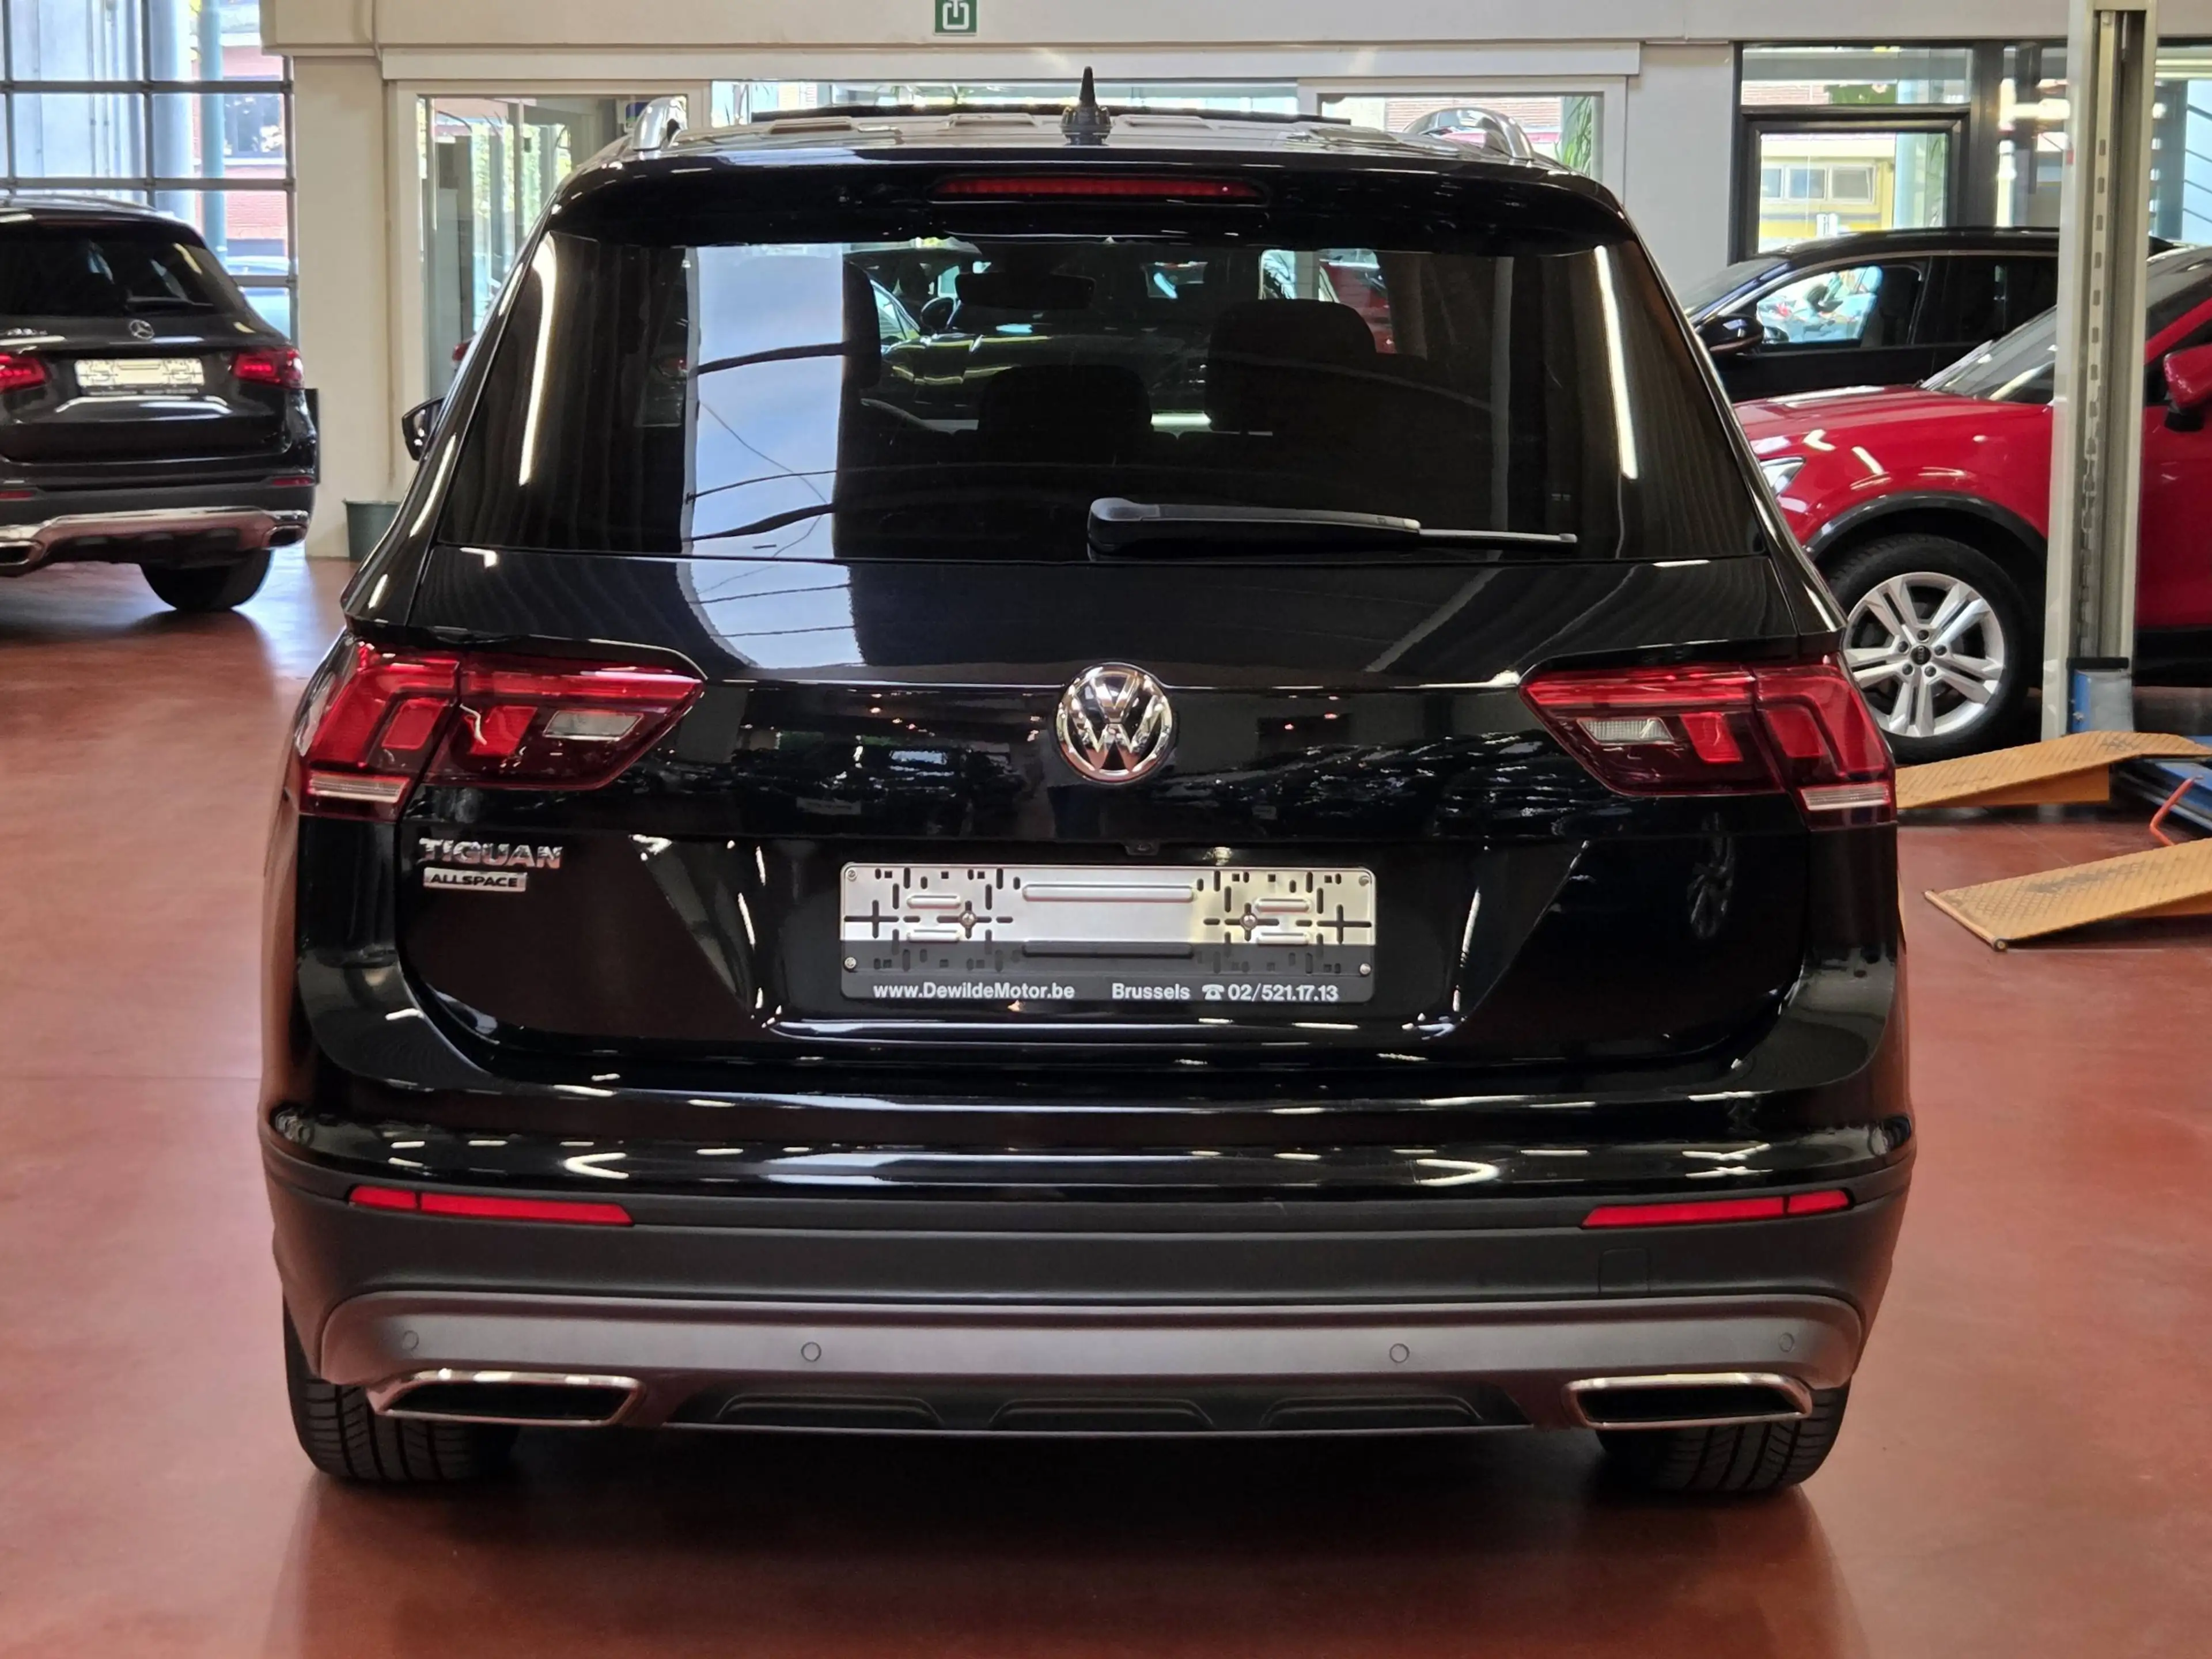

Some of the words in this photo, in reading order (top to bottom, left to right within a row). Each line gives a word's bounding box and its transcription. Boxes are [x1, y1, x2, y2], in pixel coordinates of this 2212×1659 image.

[419, 838, 563, 869] TIGUAN
[430, 874, 518, 888] ALLSPACE
[873, 982, 1075, 998] www.DewildeMotor.be
[1112, 983, 1190, 999] Brussels
[1228, 983, 1338, 1001] 02/521.17.13
